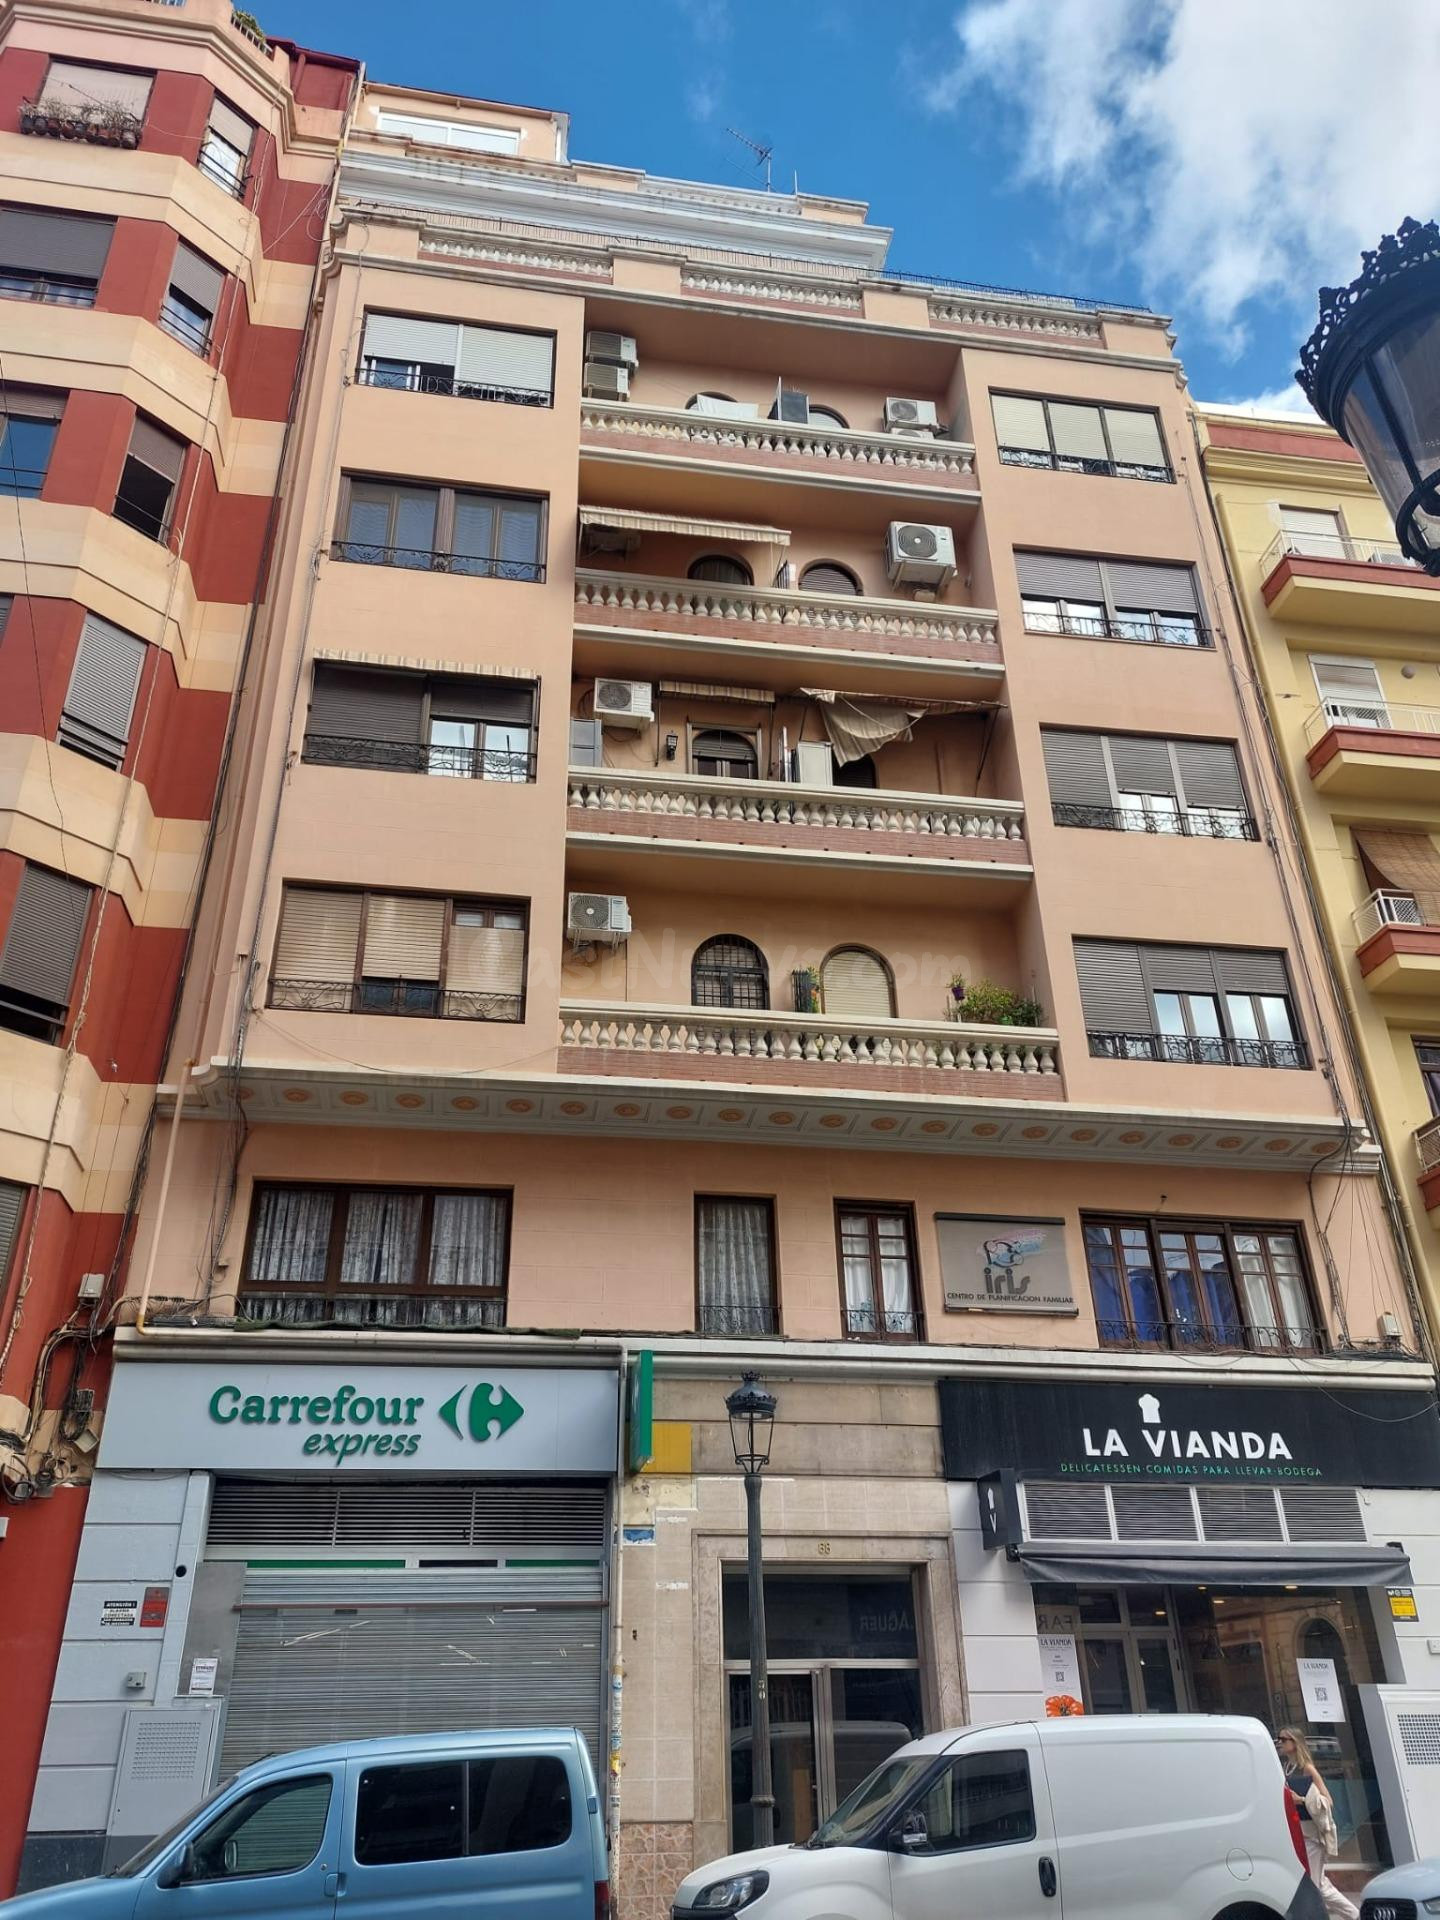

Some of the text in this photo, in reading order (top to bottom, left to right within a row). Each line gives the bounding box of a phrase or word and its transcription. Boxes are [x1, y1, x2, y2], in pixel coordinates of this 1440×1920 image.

[983, 1267, 1030, 1295] iris
[946, 1292, 974, 1300] CENTRO
[208, 1384, 425, 1425] Carrefour
[301, 1433, 423, 1468] express
[1082, 1427, 1293, 1460] LA VIANDA
[1203, 1466, 1231, 1475] PARA
[1040, 1638, 1072, 1646] LA VIANDA
